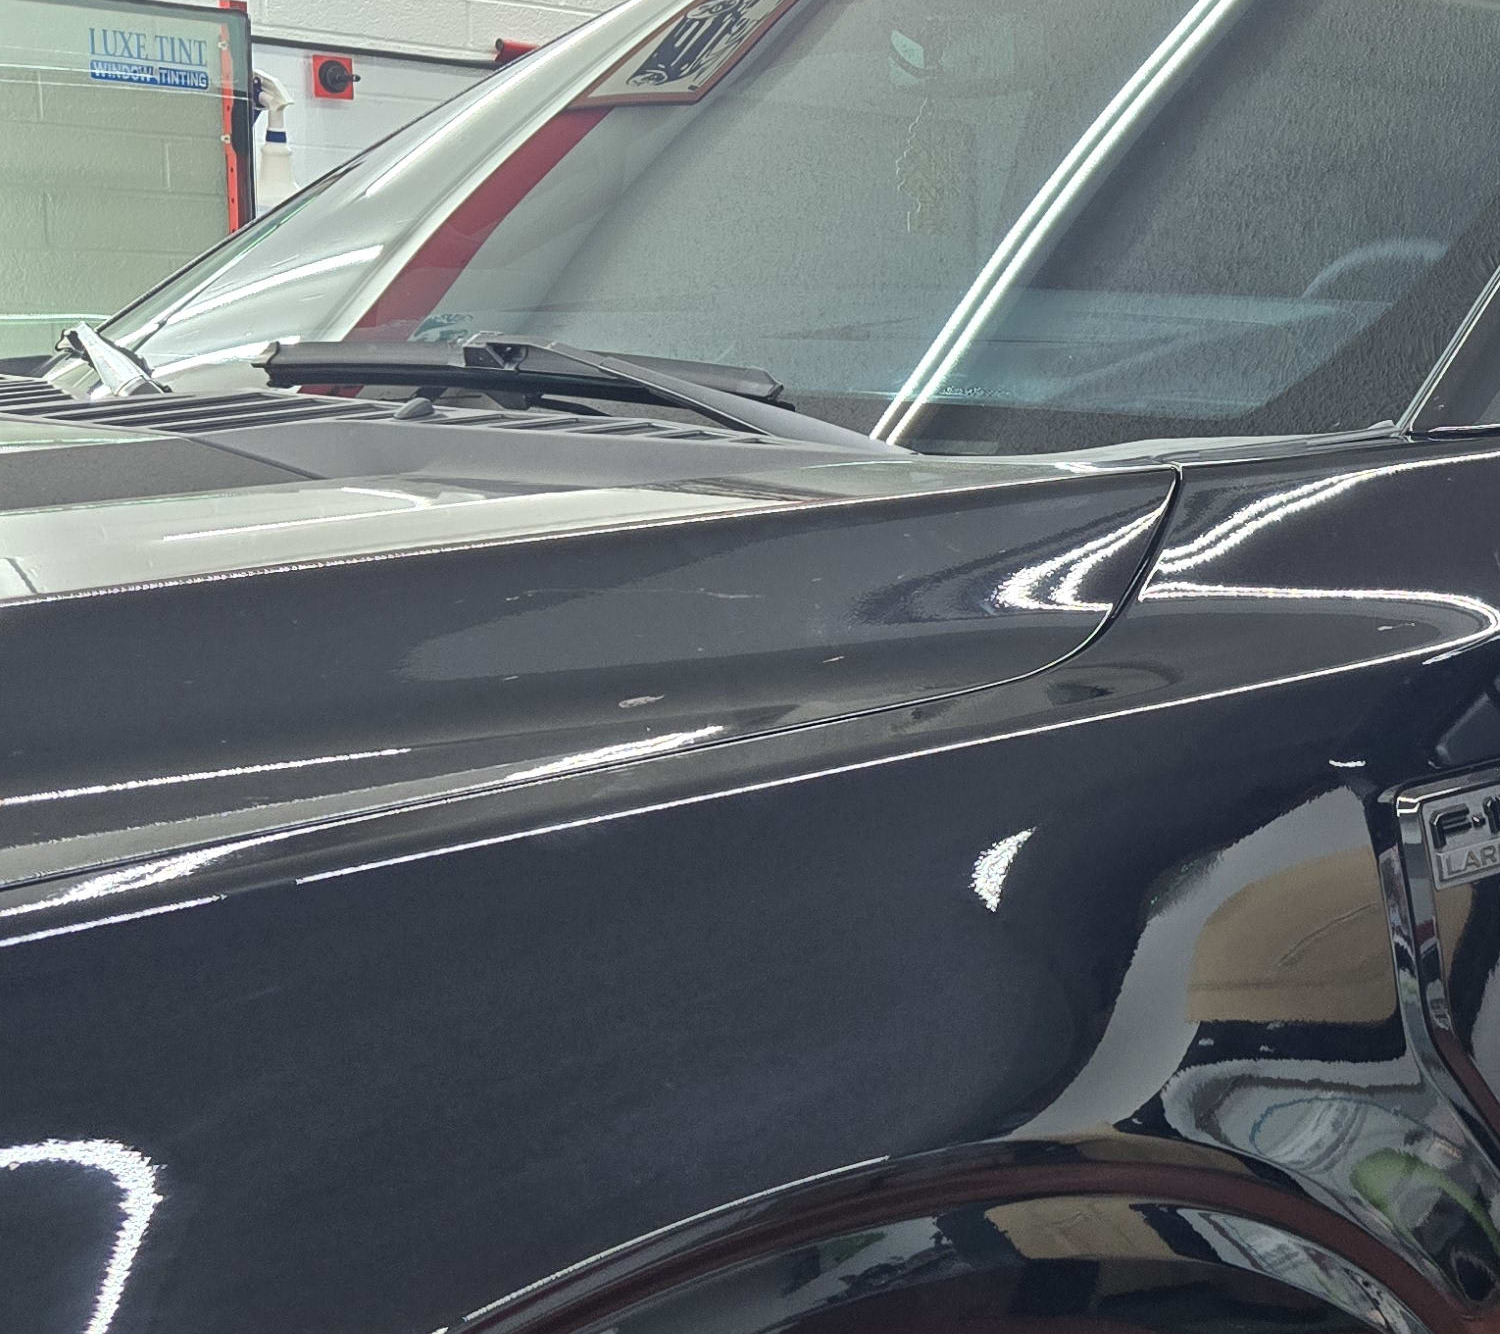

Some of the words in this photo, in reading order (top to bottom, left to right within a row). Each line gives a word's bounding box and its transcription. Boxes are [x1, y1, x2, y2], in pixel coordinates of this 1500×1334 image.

[88, 27, 149, 60] LUXE
[155, 34, 208, 66] TINT
[92, 61, 153, 83] WINDOW
[160, 69, 208, 88] TINTING
